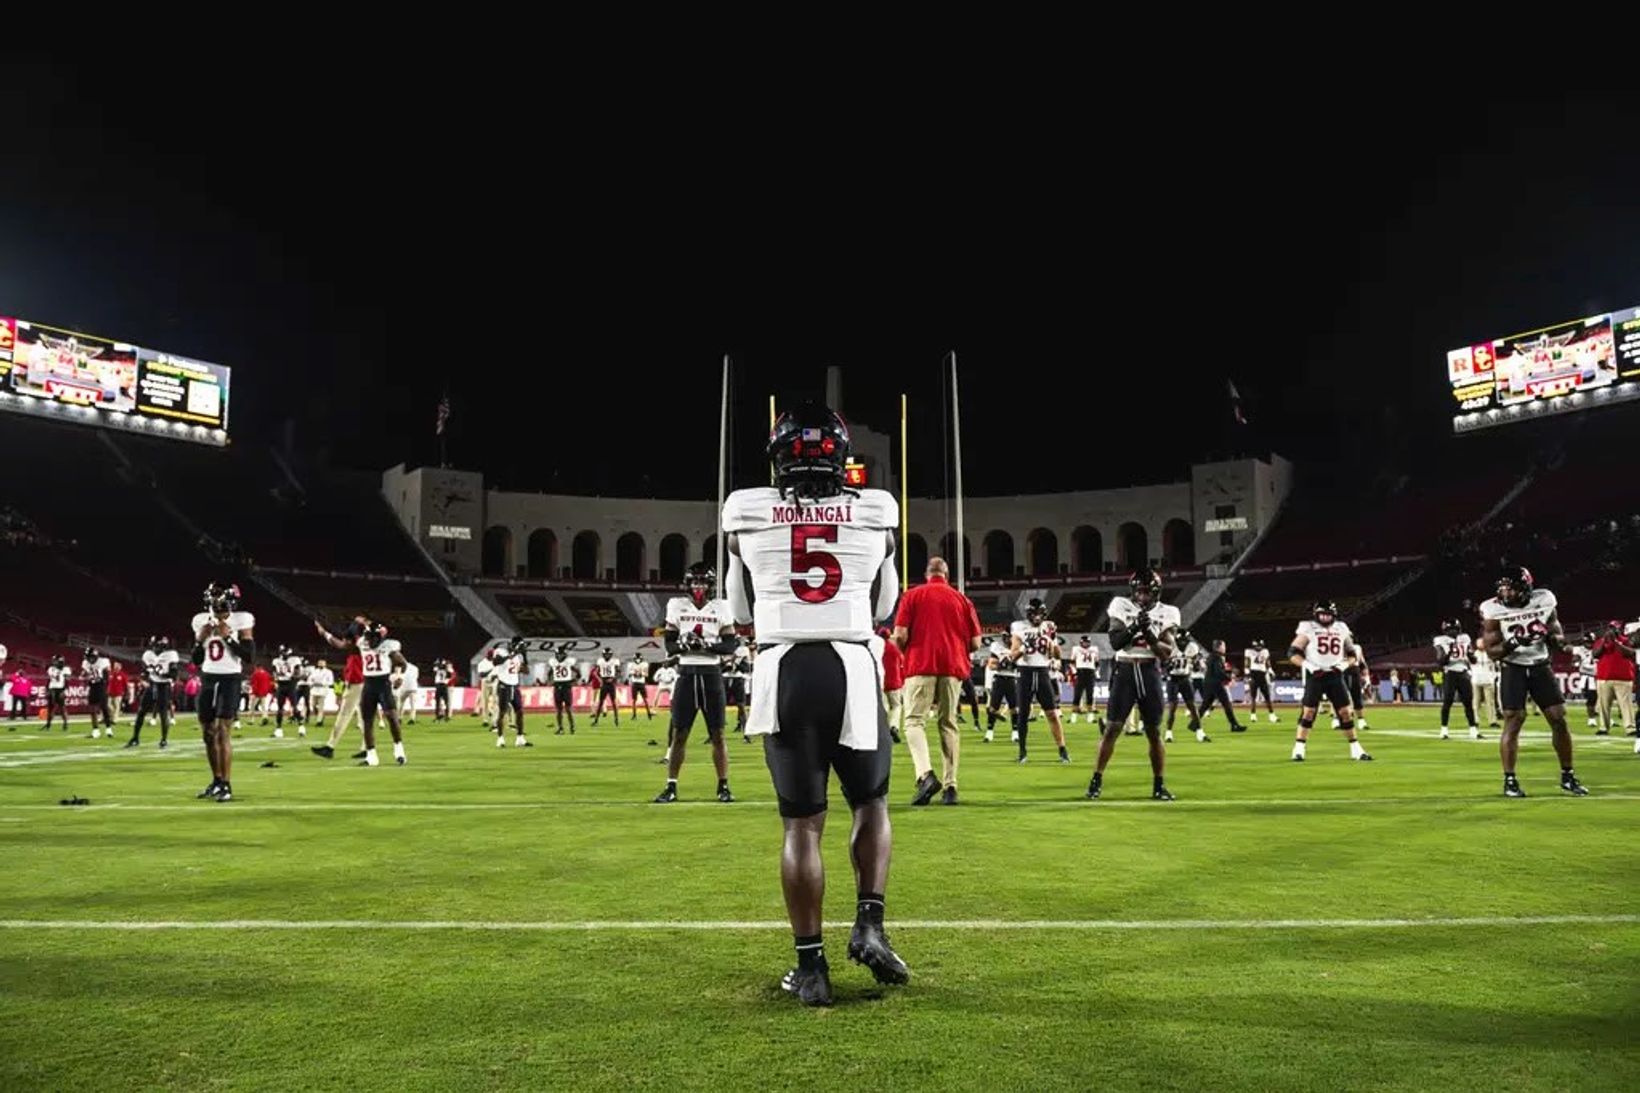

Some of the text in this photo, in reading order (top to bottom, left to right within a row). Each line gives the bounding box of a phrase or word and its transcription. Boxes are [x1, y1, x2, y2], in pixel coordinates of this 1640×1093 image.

[772, 505, 852, 524] MONANGAI
[790, 524, 843, 604] 5
[208, 640, 224, 662] 0
[1317, 636, 1341, 655] 56
[365, 653, 383, 672] 21
